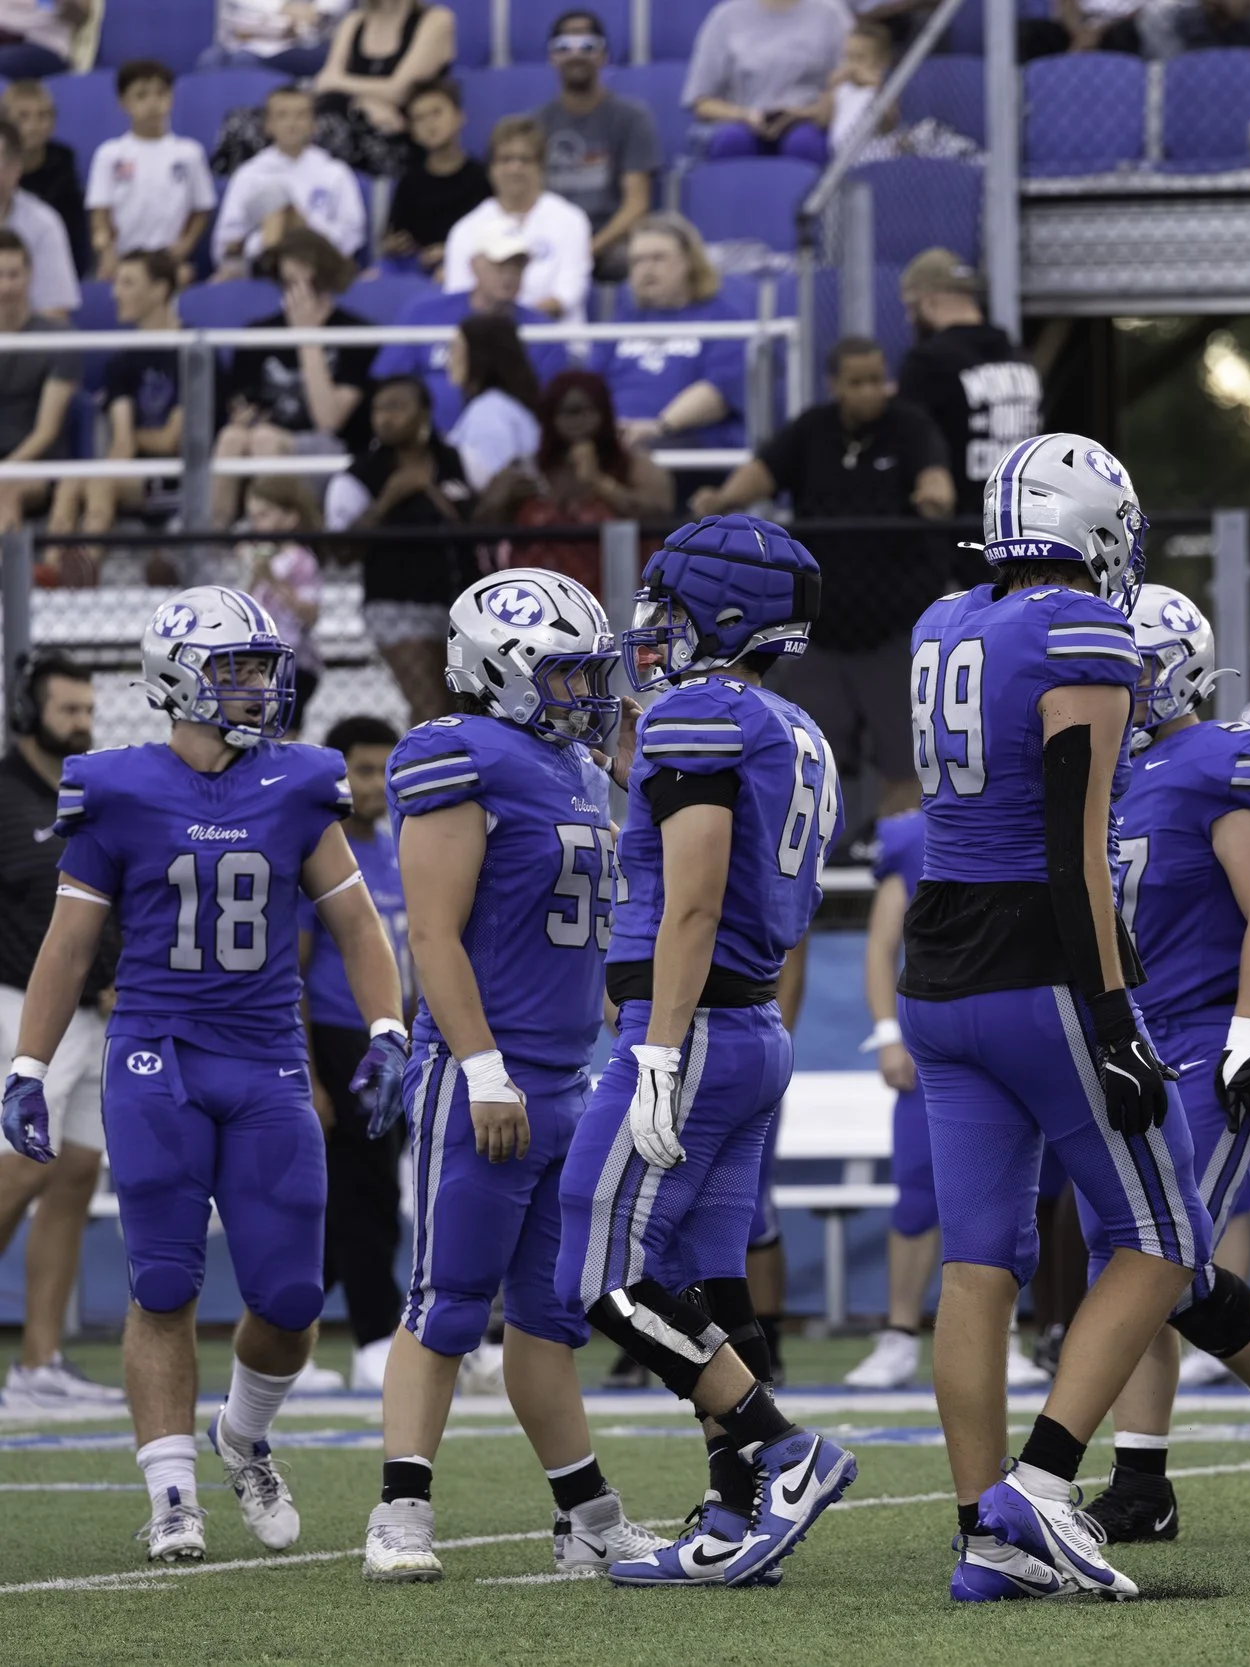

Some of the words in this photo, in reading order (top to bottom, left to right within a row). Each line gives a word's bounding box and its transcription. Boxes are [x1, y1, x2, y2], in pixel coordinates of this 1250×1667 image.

[1008, 543, 1053, 558] WAY
[154, 605, 196, 638] M
[488, 587, 541, 626] M
[1162, 600, 1202, 632] M
[910, 637, 988, 798] 89
[778, 726, 839, 887] 64
[187, 824, 248, 843] Vikings
[167, 851, 272, 973] 18
[132, 1054, 159, 1073] M
